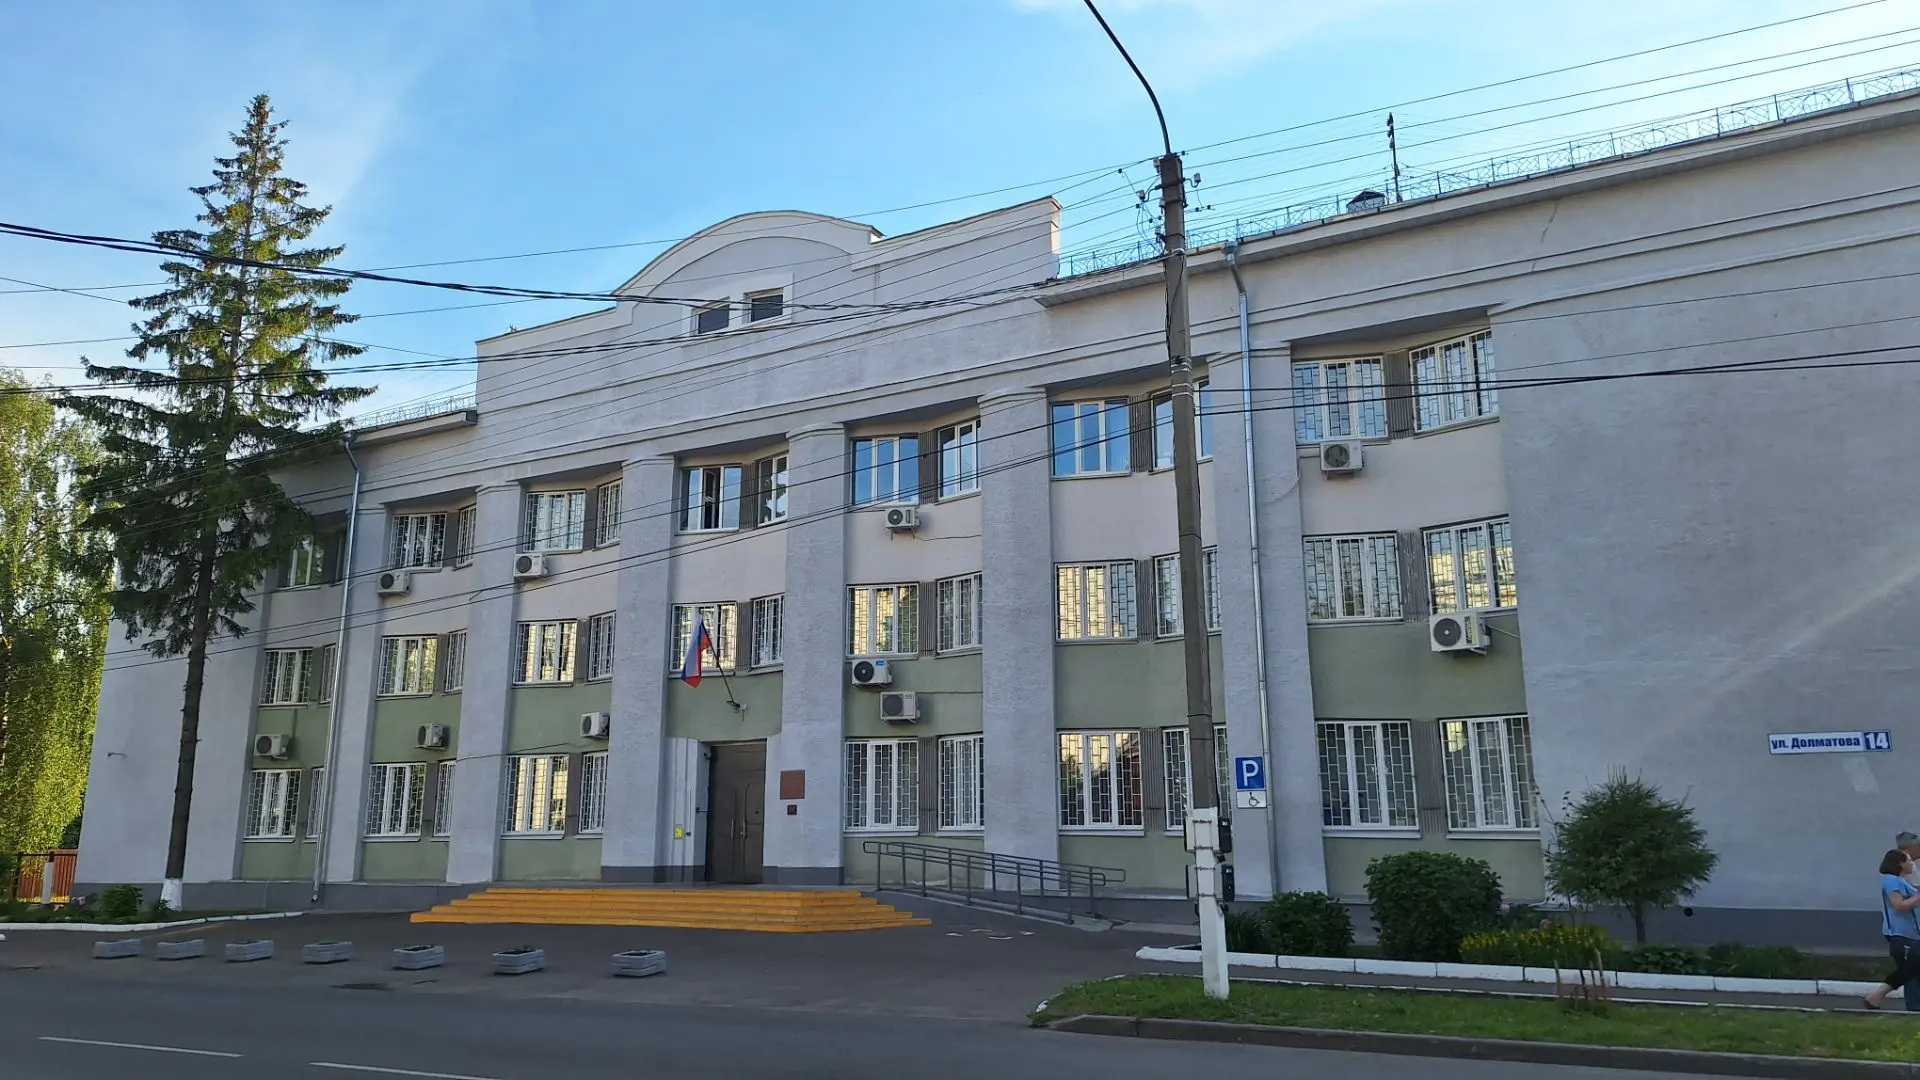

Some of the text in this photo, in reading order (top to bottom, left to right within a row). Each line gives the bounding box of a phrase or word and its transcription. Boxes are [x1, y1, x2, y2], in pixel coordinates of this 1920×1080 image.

[1771, 732, 1888, 749] ул. Долматова 14
[1242, 760, 1258, 786] P
